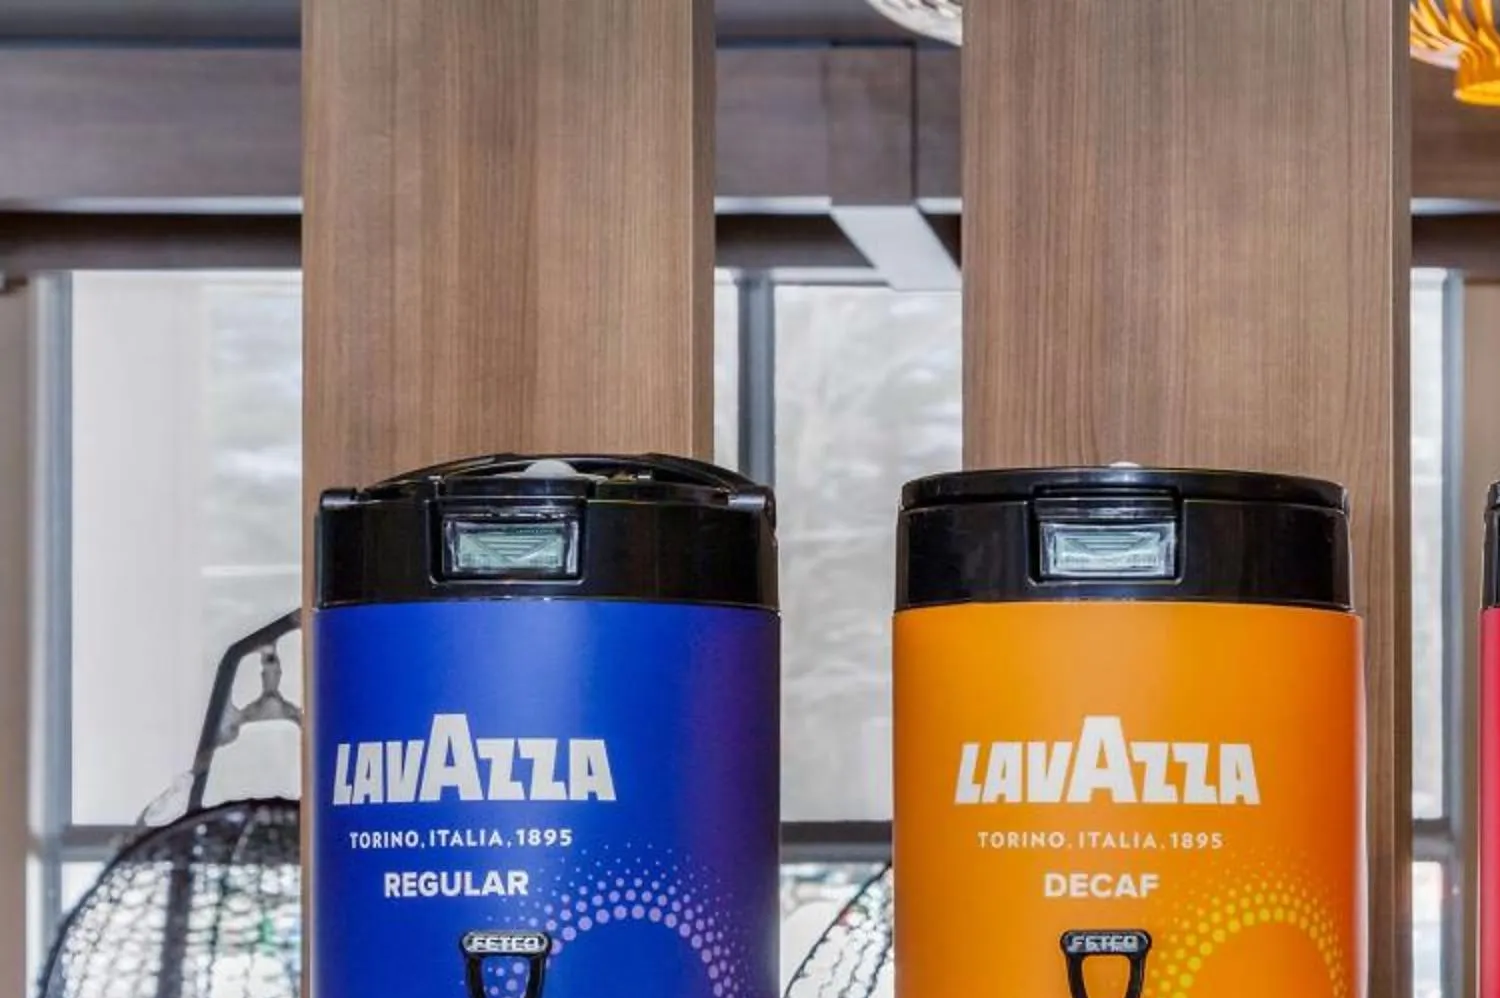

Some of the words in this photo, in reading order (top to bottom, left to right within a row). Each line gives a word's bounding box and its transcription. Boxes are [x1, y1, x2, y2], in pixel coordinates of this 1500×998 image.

[333, 713, 616, 805] LAVAZZA
[955, 715, 1260, 805] LAVAZZA
[516, 829, 573, 846] 1895
[1170, 832, 1223, 849] 1895
[384, 870, 529, 898] REGULAR
[1044, 872, 1160, 898] DECAF
